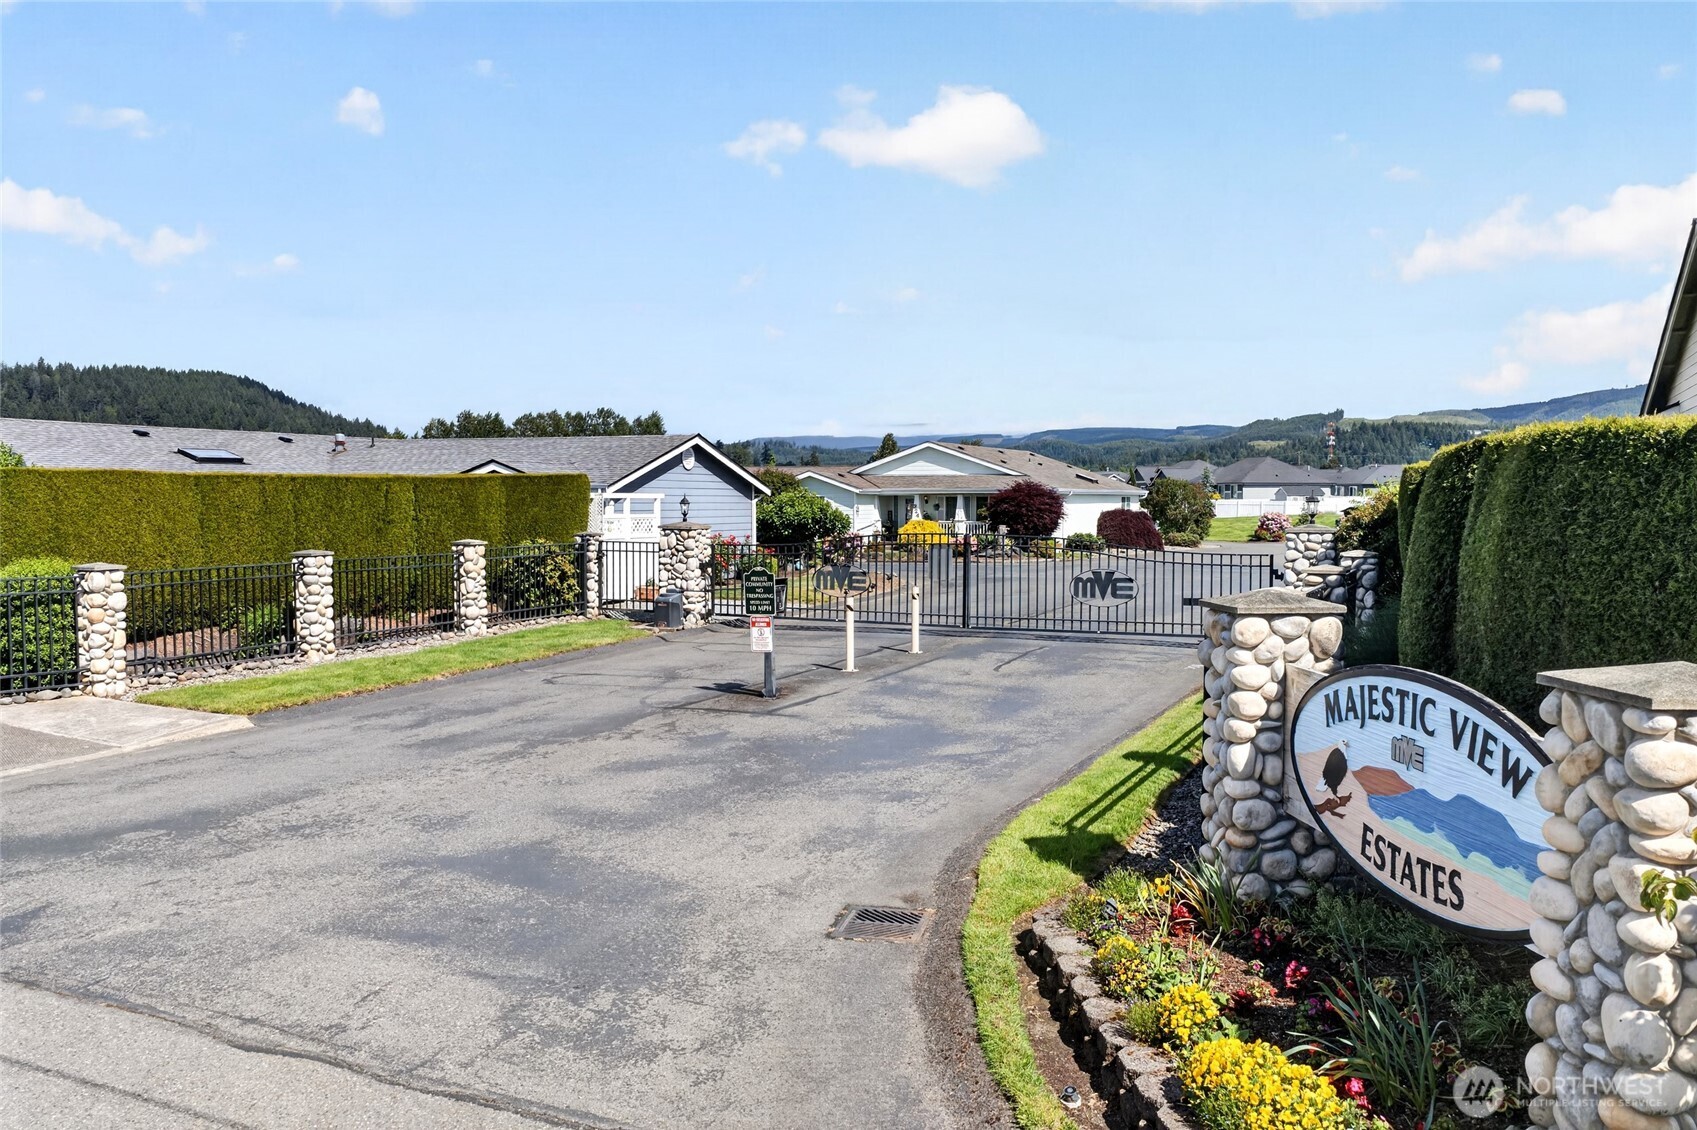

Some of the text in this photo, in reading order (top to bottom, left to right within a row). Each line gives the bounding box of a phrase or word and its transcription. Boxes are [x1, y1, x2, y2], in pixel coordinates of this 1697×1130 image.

[1323, 684, 1534, 799] MAJESTIC VIEW
[1360, 821, 1465, 912] ESTATES
